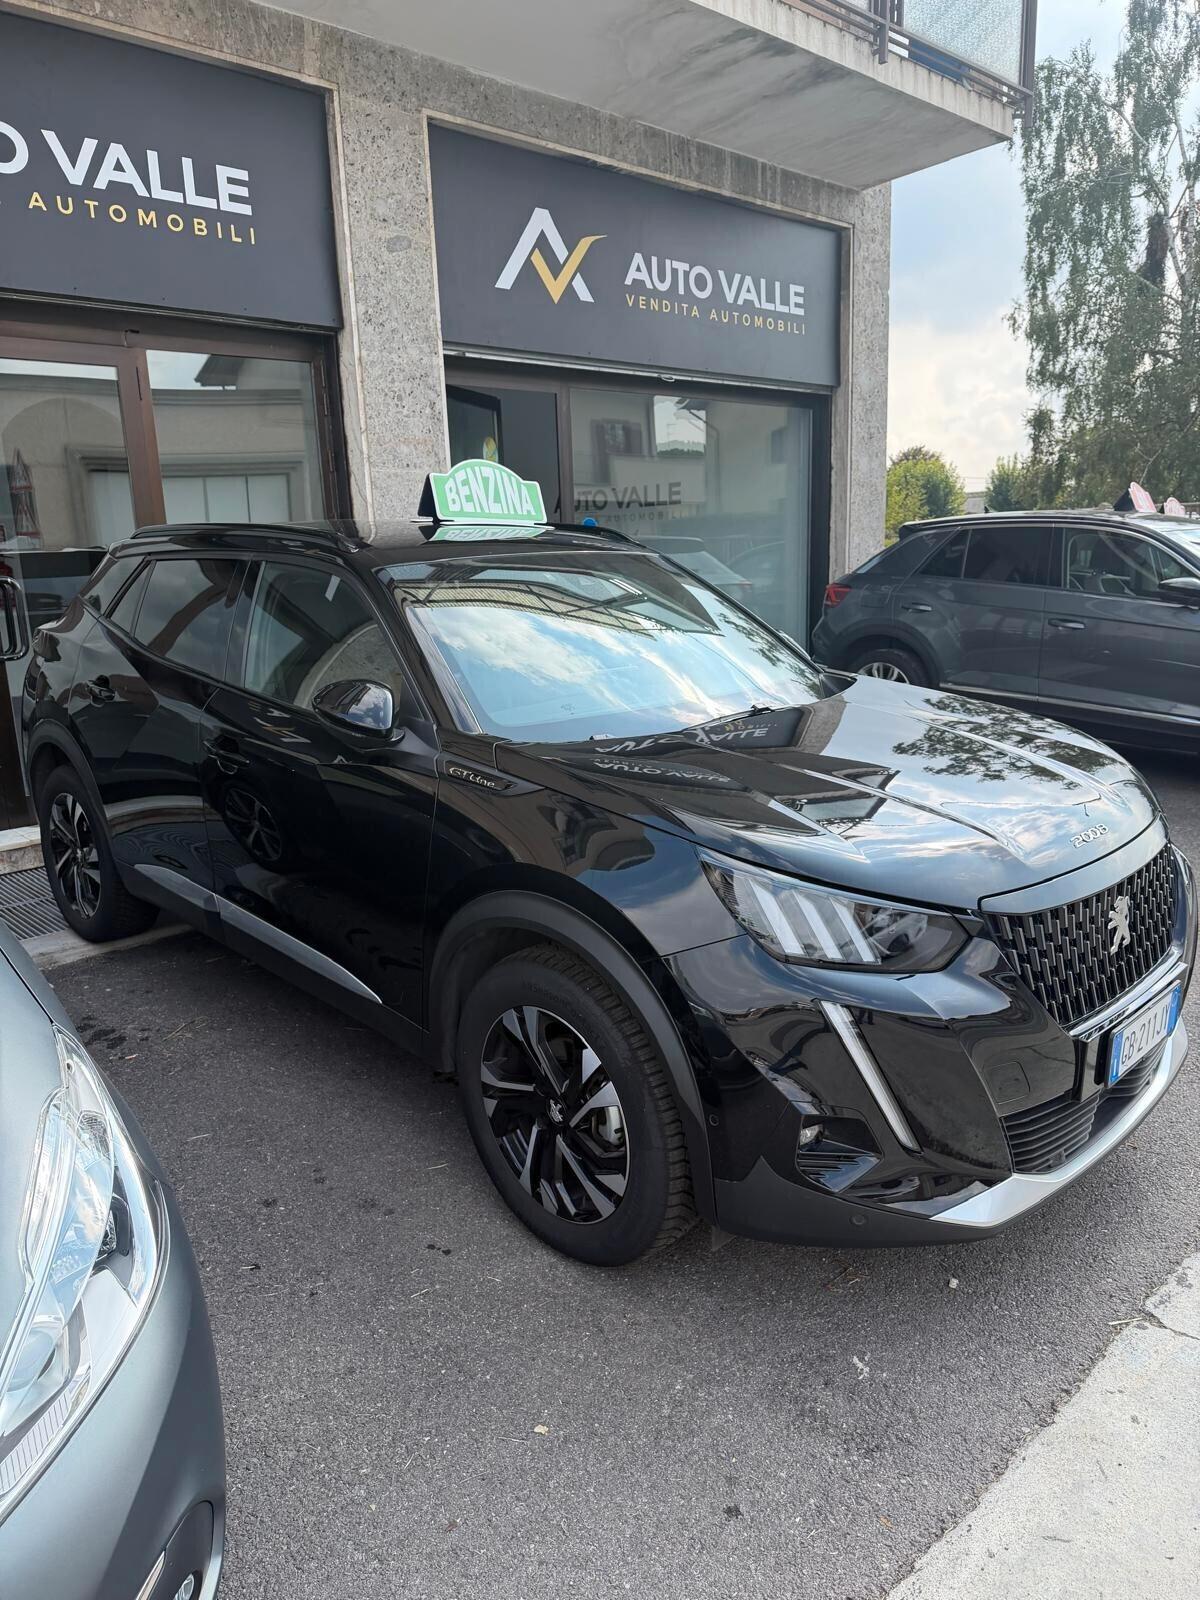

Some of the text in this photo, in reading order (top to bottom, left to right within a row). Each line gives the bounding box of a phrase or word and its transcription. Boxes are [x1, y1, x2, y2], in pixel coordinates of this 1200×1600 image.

[41, 129, 253, 216] VALLE
[28, 191, 256, 245] AUTOMOBILI
[624, 252, 805, 316] AUTO VALLE
[625, 293, 806, 336] VENDITA AUTOMOBILI
[444, 466, 536, 515] BENZINA
[612, 481, 682, 509] VALLE
[1069, 823, 1109, 849] 2008
